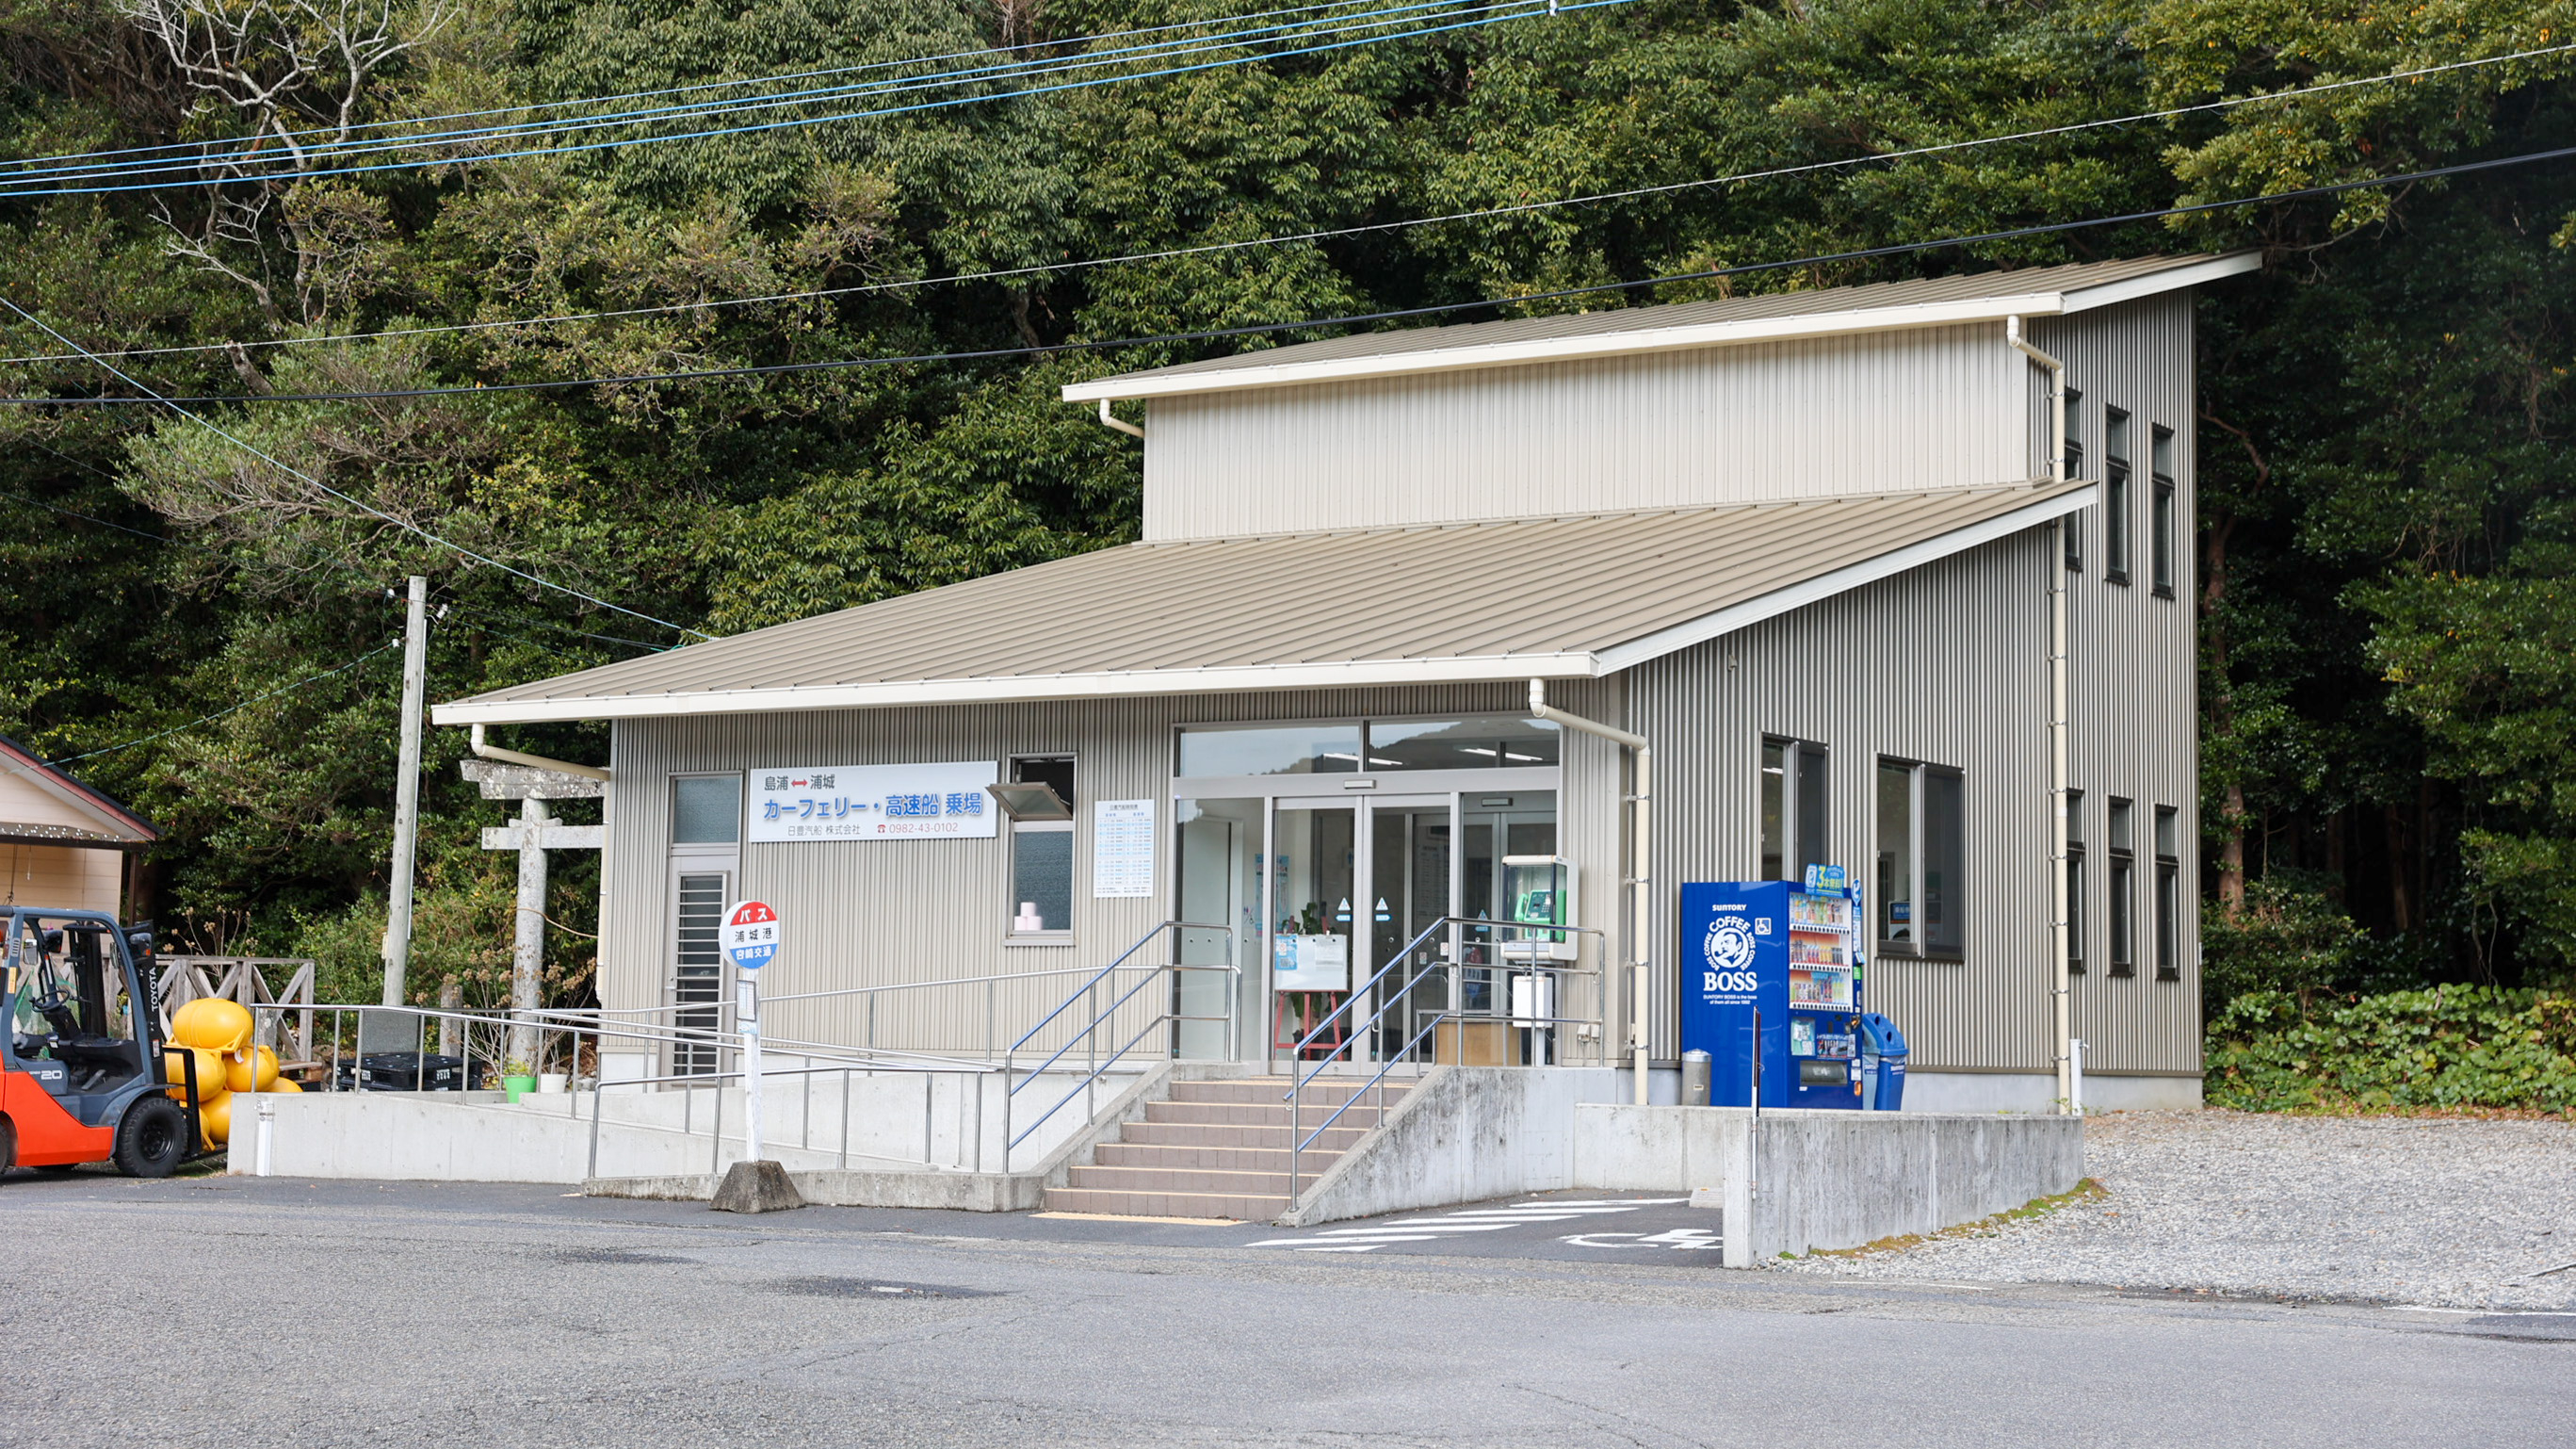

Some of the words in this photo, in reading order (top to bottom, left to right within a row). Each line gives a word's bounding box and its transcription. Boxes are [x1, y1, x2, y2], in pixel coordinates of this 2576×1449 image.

[764, 775, 788, 790] 島浦
[810, 773, 835, 790] 浦城
[764, 793, 939, 819] カーフェリー・高速船
[946, 792, 981, 814] 乗場
[787, 825, 822, 837] 日豊汽船
[825, 824, 861, 836] 株式会社
[888, 822, 959, 834] 0982-43-0102
[739, 907, 768, 922] バス
[1711, 904, 1747, 912] SUNTORY
[1709, 915, 1752, 934] COFFEE
[736, 927, 772, 943] 浦城港
[1745, 931, 1757, 950] BOSS
[1703, 932, 1714, 956] COFFEE
[736, 945, 771, 961] 宮崎交通
[1739, 949, 1757, 971] COFFEE
[1706, 955, 1721, 972] BOSS
[149, 967, 159, 1012] TOYOTA
[1702, 971, 1758, 992] BOSS
[41, 1070, 63, 1080] 20
